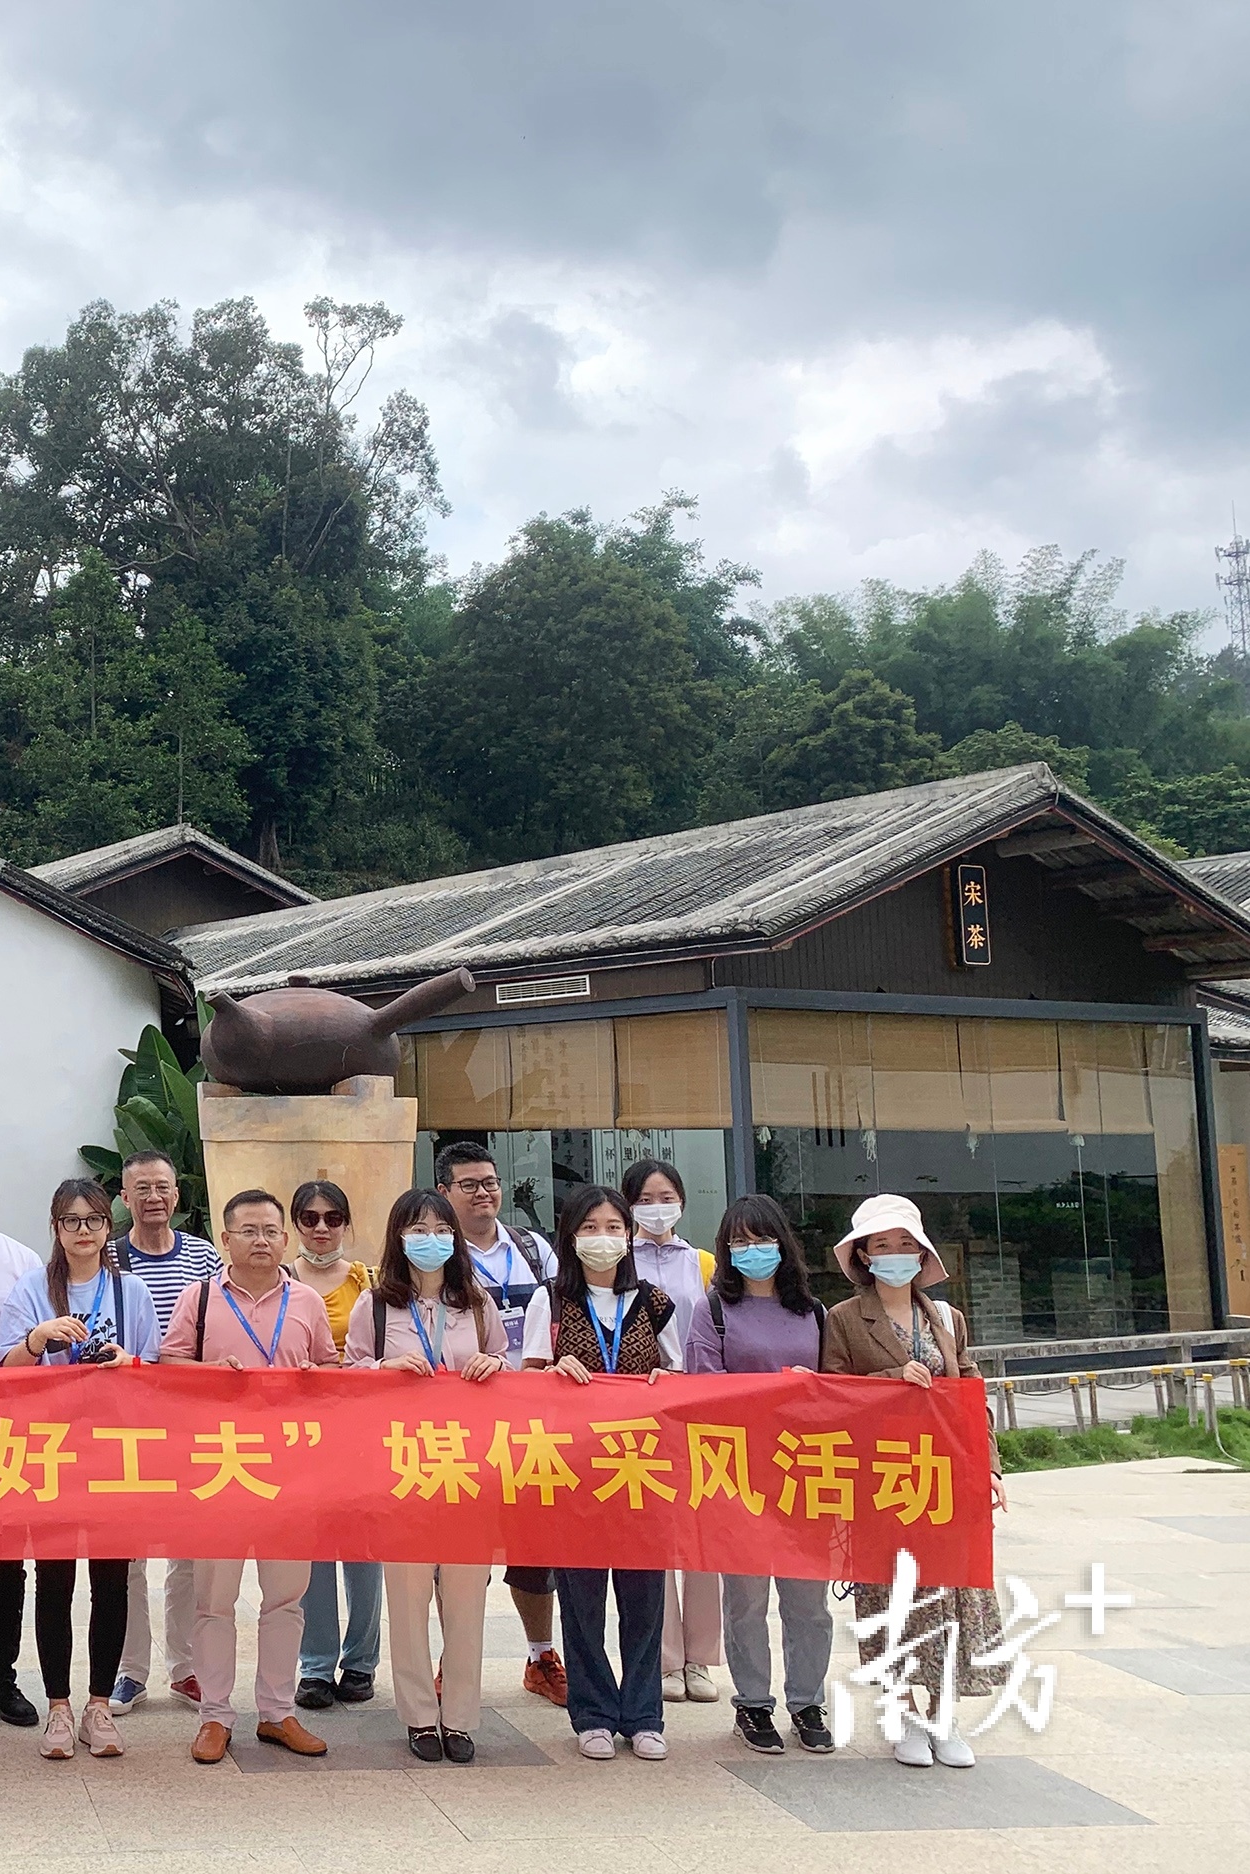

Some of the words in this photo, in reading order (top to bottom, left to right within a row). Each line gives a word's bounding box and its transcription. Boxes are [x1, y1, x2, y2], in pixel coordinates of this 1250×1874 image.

[962, 880, 986, 950] 宋茶
[382, 1416, 953, 1526] 媒体采风活动
